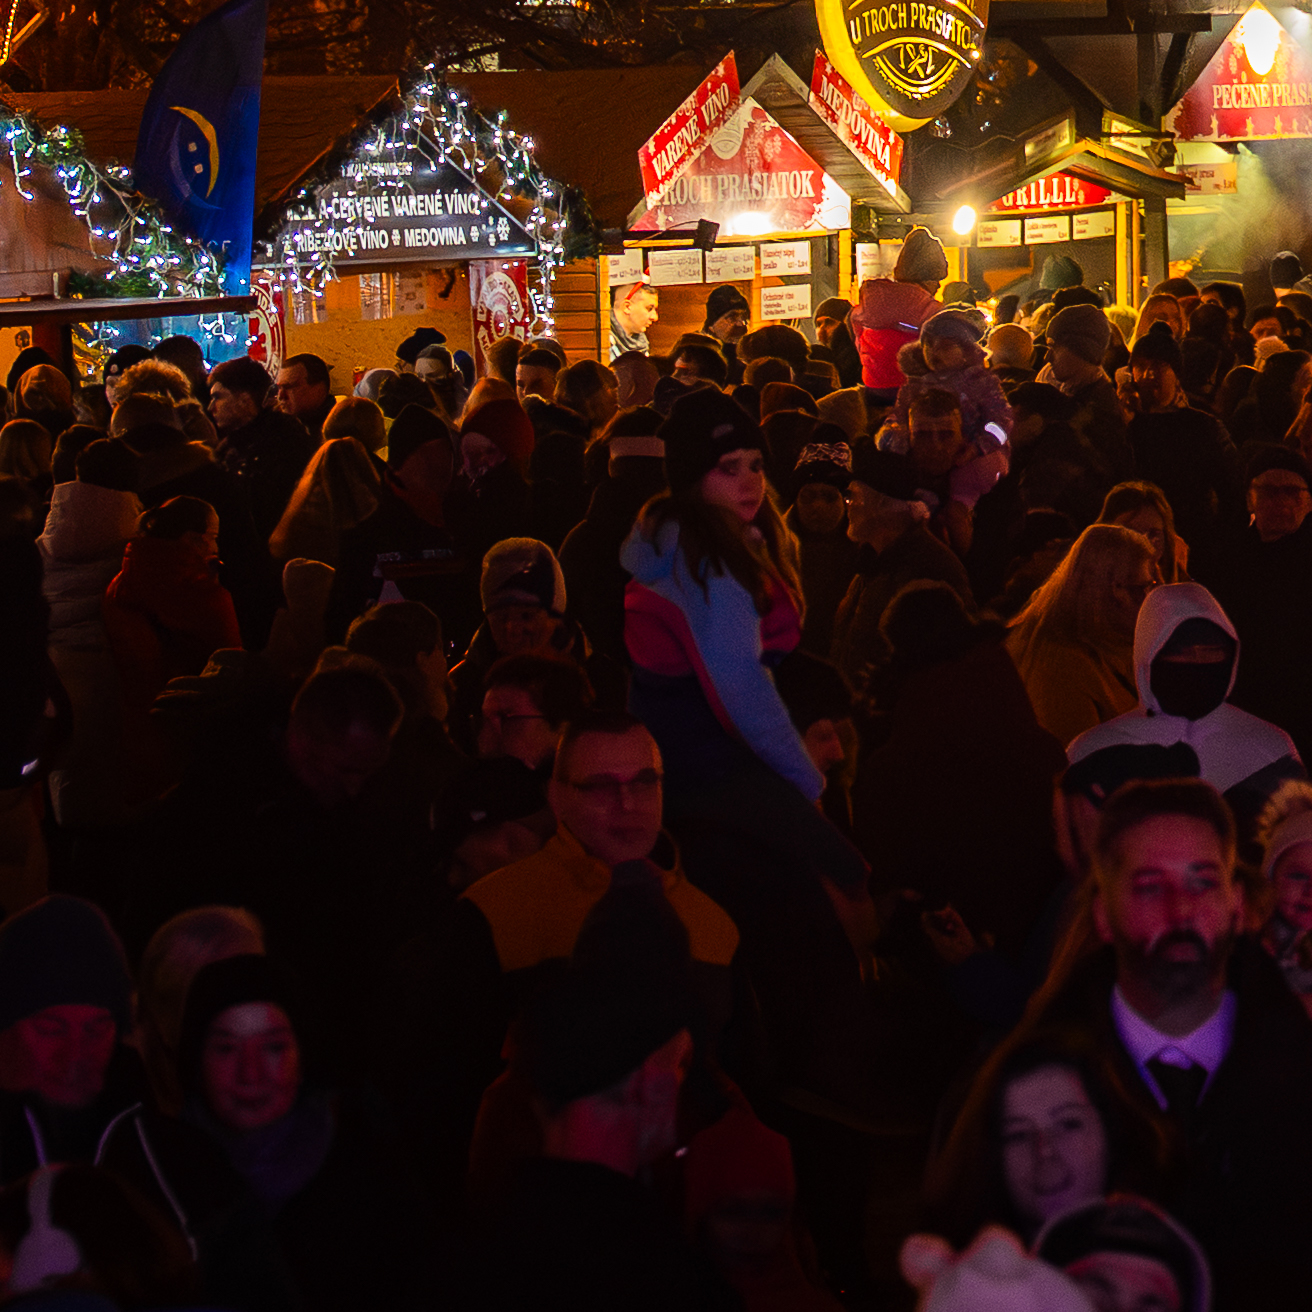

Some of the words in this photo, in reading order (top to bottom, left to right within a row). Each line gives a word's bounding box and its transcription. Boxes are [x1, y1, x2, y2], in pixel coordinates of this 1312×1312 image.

[850, 17, 862, 44] U
[862, 3, 907, 36] TROCH
[819, 74, 891, 171] MEDOVINA
[331, 190, 390, 220] ČERVENÉ
[391, 189, 443, 217] VARENÉ
[444, 188, 479, 215] VÍNO
[655, 175, 713, 206] ROCH
[717, 170, 816, 202] PRASIATOK
[359, 225, 389, 249] VÍNO
[404, 227, 467, 248] MEDOVINA
